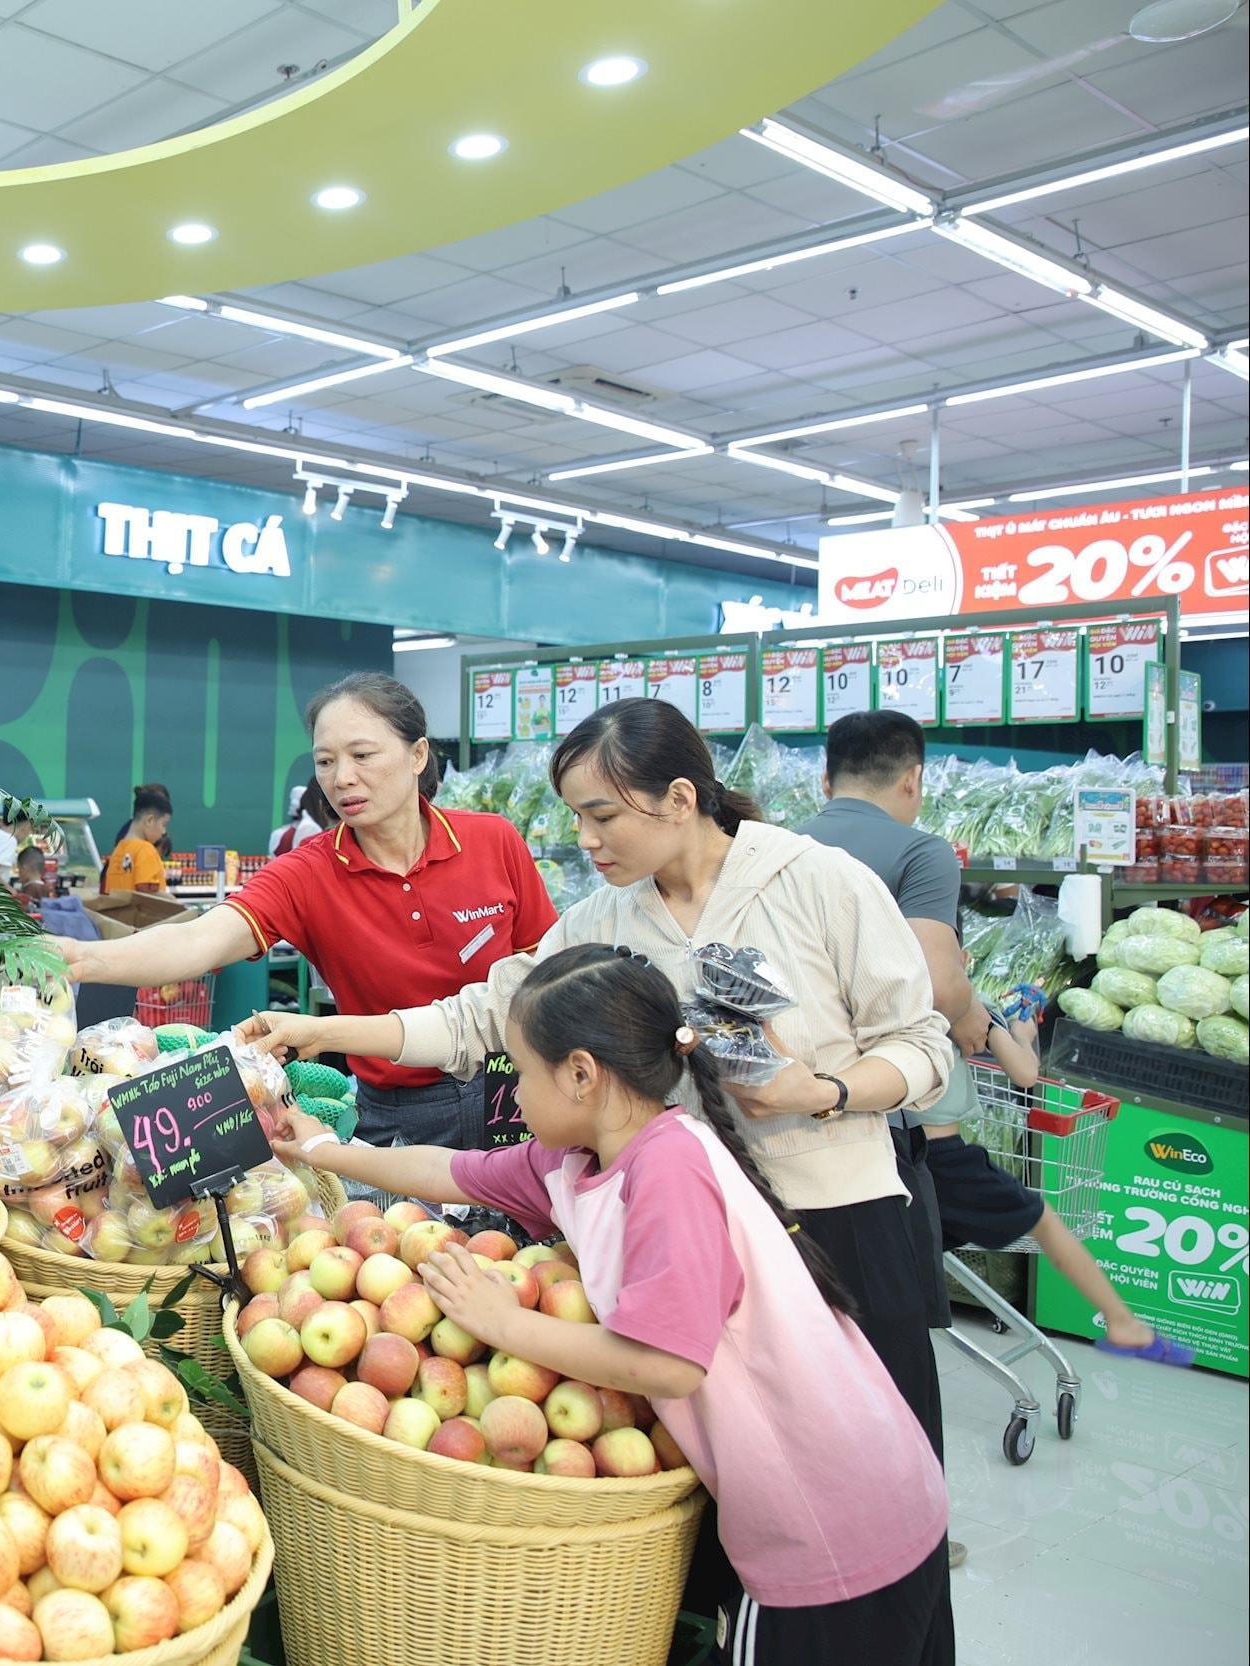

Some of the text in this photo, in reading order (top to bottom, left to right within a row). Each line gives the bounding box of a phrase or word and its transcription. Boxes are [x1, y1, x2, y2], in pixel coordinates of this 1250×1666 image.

[97, 502, 291, 577] THỊT CÁ
[1018, 530, 1196, 605] 20%
[841, 579, 896, 600] MEAT
[949, 664, 961, 683] 7
[1016, 660, 1045, 680] 17
[1094, 654, 1124, 675] 10
[767, 676, 791, 694] 12
[827, 672, 849, 691] 10
[885, 668, 908, 687] 10
[559, 688, 577, 703] 12
[702, 680, 712, 696] 8
[478, 694, 494, 709] 12
[452, 902, 505, 923] WinMart
[486, 1055, 514, 1074] Nho
[160, 1070, 178, 1089] Fuji
[179, 1062, 202, 1080] Nam
[187, 1092, 213, 1111] 900
[1150, 1142, 1207, 1164] WinEco
[3, 1149, 106, 1197] Ited
[65, 1172, 108, 1199] Fruit
[1123, 1185, 1177, 1203] TRƯỜNG
[1133, 1175, 1221, 1199] RAU CỦ SẠCH
[1116, 1206, 1249, 1276] 20%
[1120, 1263, 1159, 1279] QUYỀN
[1110, 1272, 1158, 1290] HỘI VIÊN
